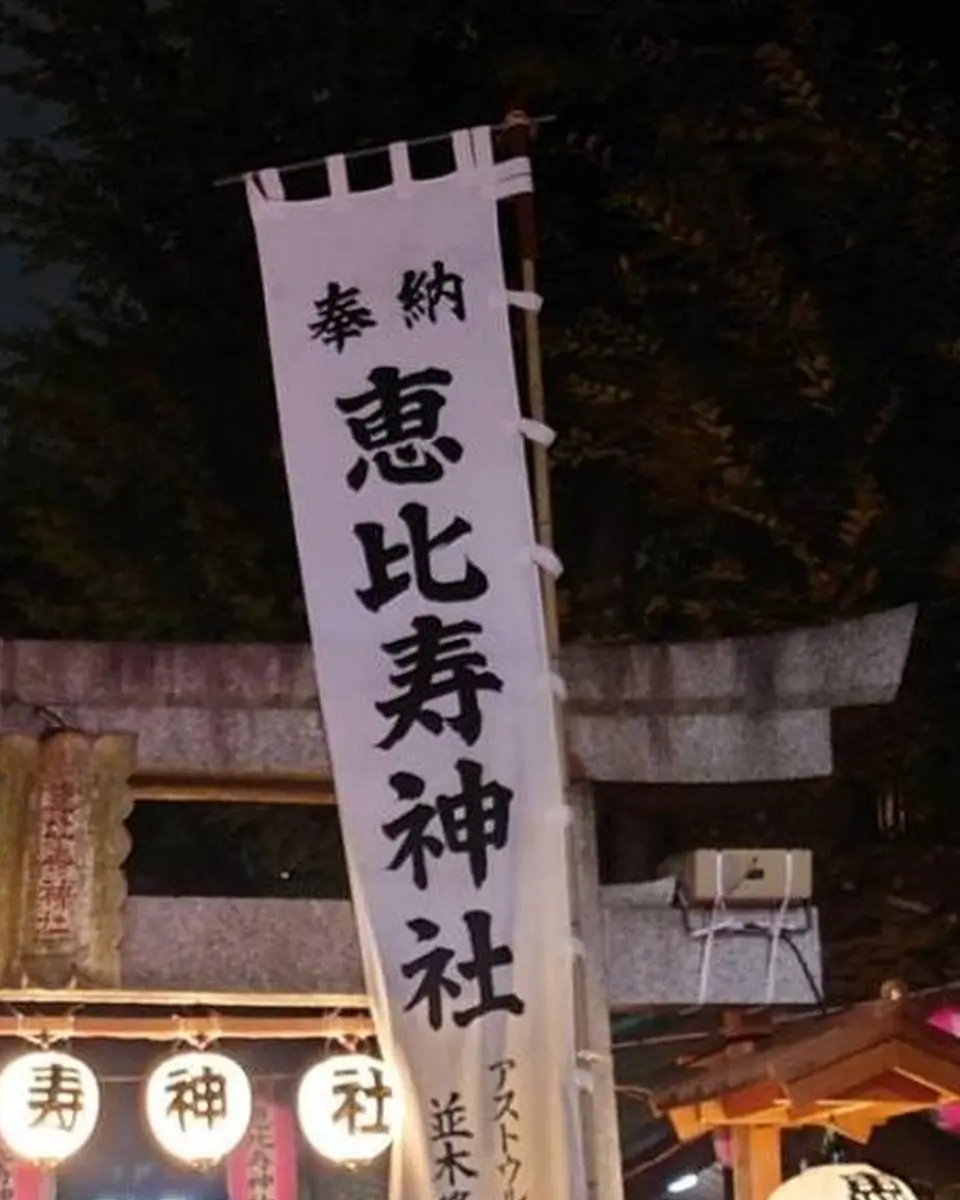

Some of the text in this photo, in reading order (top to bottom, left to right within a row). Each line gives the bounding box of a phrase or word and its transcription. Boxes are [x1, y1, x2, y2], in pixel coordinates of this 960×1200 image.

[308, 260, 467, 354] 奉納
[334, 366, 527, 1032] 恵比寿神社
[28, 1062, 83, 1132] 寿
[165, 1065, 228, 1133] 神
[332, 1066, 393, 1135] 社
